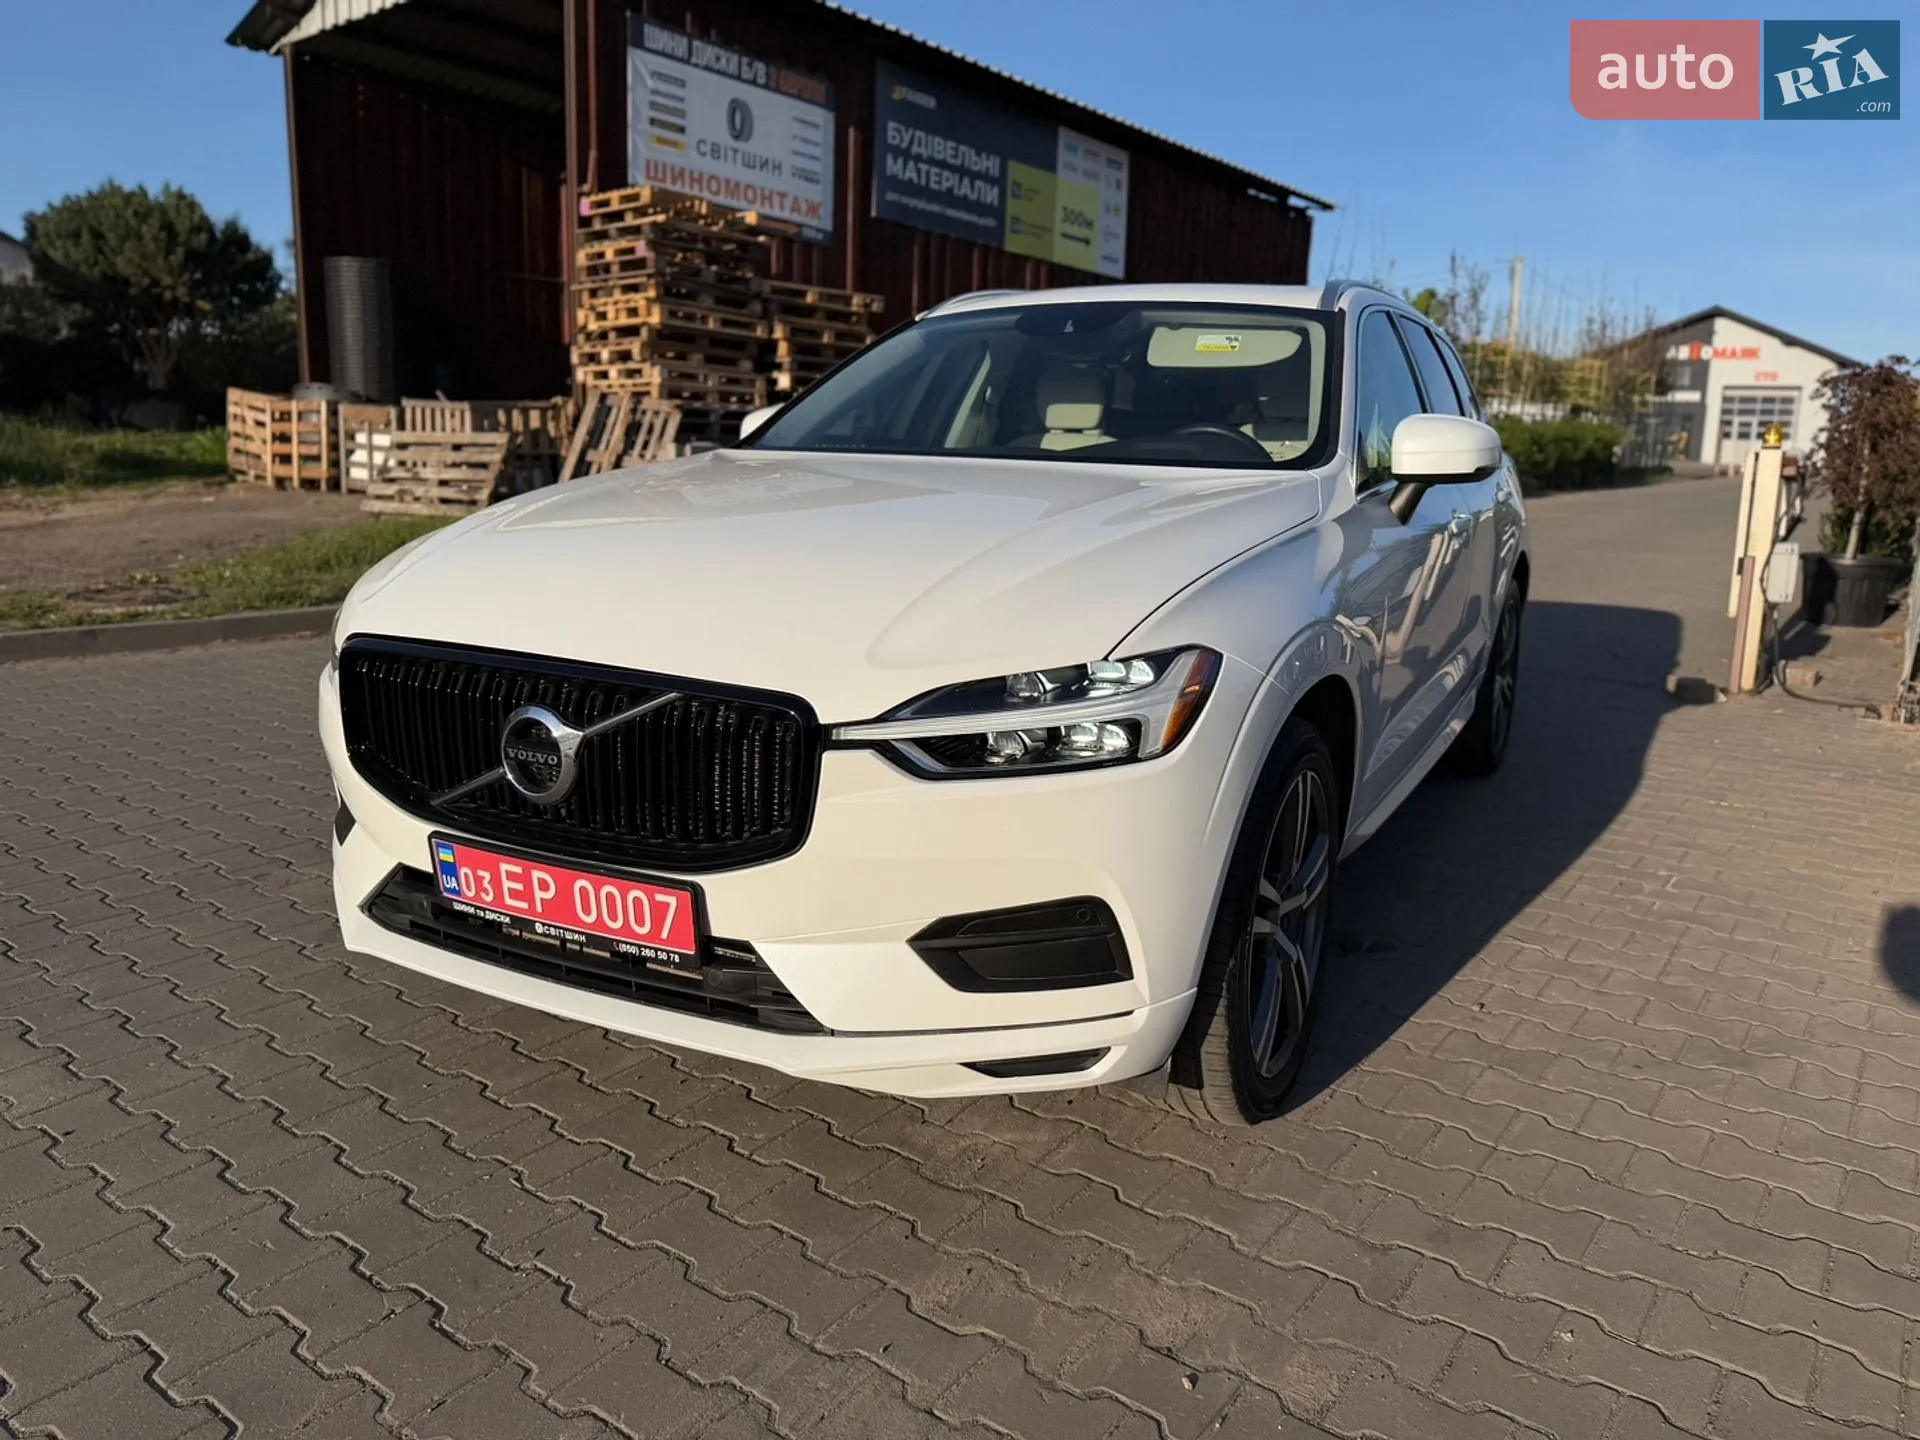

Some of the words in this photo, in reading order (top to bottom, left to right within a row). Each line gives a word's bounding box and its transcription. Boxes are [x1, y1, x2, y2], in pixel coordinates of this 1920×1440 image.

[643, 22, 689, 61] ШИНИ
[690, 40, 739, 77] ДИСКИ
[740, 55, 768, 85] Б/В
[695, 139, 783, 177] СВІТШИН
[886, 119, 1001, 178] БУДІВЕЛЬНІ
[645, 158, 822, 221] ШИНОМОНТАЖ
[886, 152, 1000, 208] МАТЕРІАЛИ
[506, 746, 559, 766] VOLVO
[442, 873, 459, 891] UA
[459, 865, 495, 903] 03
[498, 860, 557, 914] EP
[573, 878, 679, 941] 0007
[485, 910, 512, 925] ДИСКИ
[543, 927, 587, 944] СВІТШИН
[655, 951, 668, 961] 50
